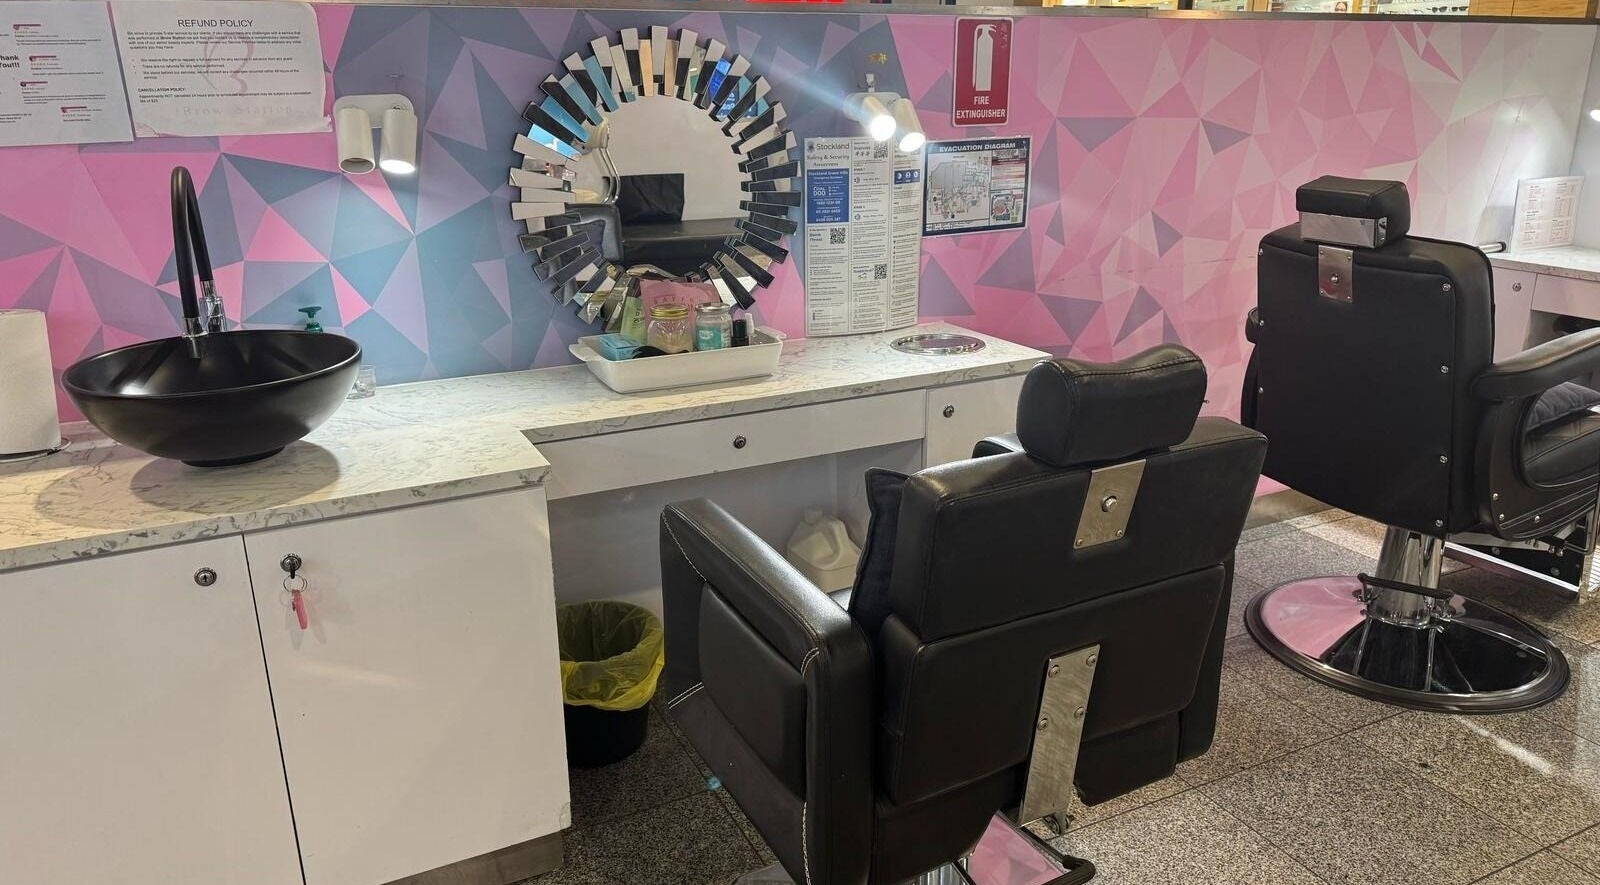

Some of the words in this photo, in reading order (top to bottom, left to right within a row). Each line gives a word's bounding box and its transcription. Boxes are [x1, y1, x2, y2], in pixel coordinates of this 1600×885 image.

[177, 20, 218, 28] REFUND
[220, 20, 254, 28] POLICY
[974, 96, 990, 105] FIRE
[956, 109, 1006, 118] EXTINGUISHER
[940, 144, 982, 152] EVACUATION
